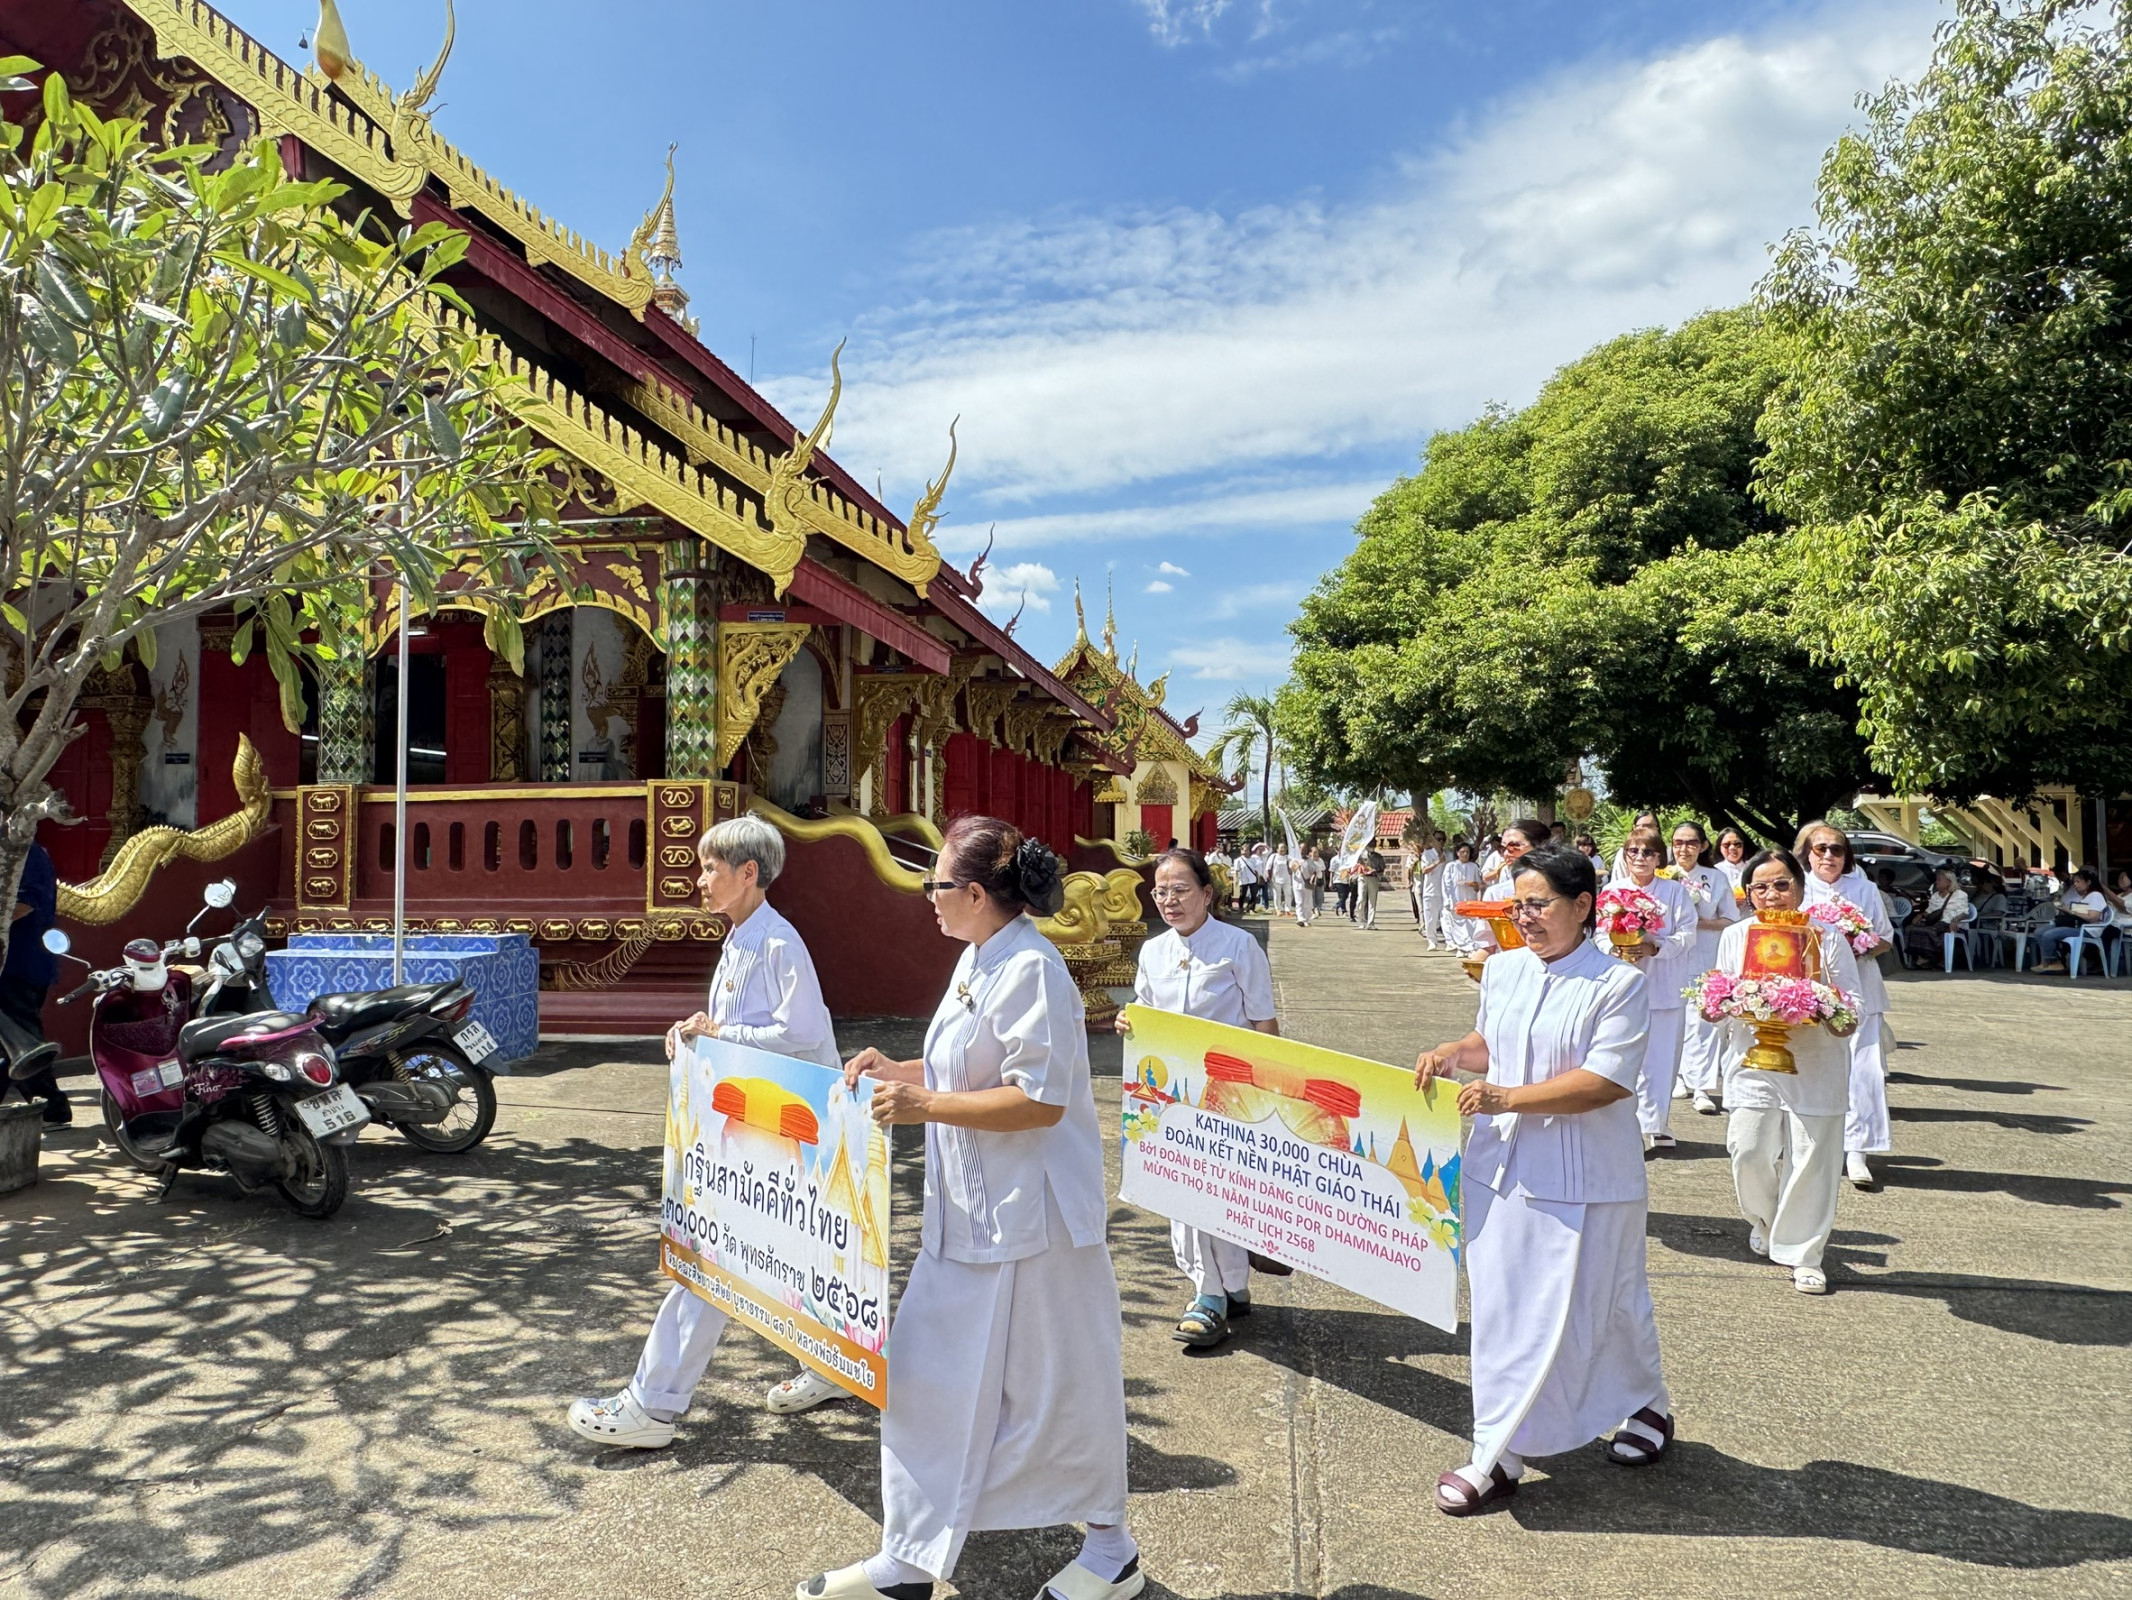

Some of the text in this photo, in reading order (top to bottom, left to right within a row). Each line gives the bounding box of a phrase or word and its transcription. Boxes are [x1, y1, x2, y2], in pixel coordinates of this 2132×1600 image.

[194, 1082, 222, 1096] Fino
[324, 1111, 356, 1130] 516
[1165, 1126, 1400, 1219] ĐOÀN KẾT NỀN PHẬT GIÁO THÁI
[1195, 1113, 1364, 1181] KATHINA 30,000 CHÙA
[684, 1142, 848, 1250] กฐินสามัคคีทั่วไทย
[1143, 1160, 1421, 1272] MỪNG THỌ 81 NĂM LUANG POR DHAMMAJAYO
[1159, 1147, 1190, 1168] ĐOÀN
[1193, 1158, 1207, 1176] ĐỆ
[1229, 1170, 1256, 1191] KÍNH
[1259, 1181, 1294, 1205] DÂNG
[1297, 1194, 1333, 1218] CÚNG
[1337, 1208, 1388, 1238] DƯỜNG
[1392, 1228, 1429, 1253] PHÁP
[1226, 1208, 1315, 1253] PHẬT LỊCH 2568
[722, 1223, 737, 1256] วัด
[740, 1240, 806, 1293] พุทธศักราช
[811, 1265, 879, 1332] ๒๕๖๘
[733, 1292, 771, 1325] บูชาธรรม
[787, 1319, 794, 1340] ปี
